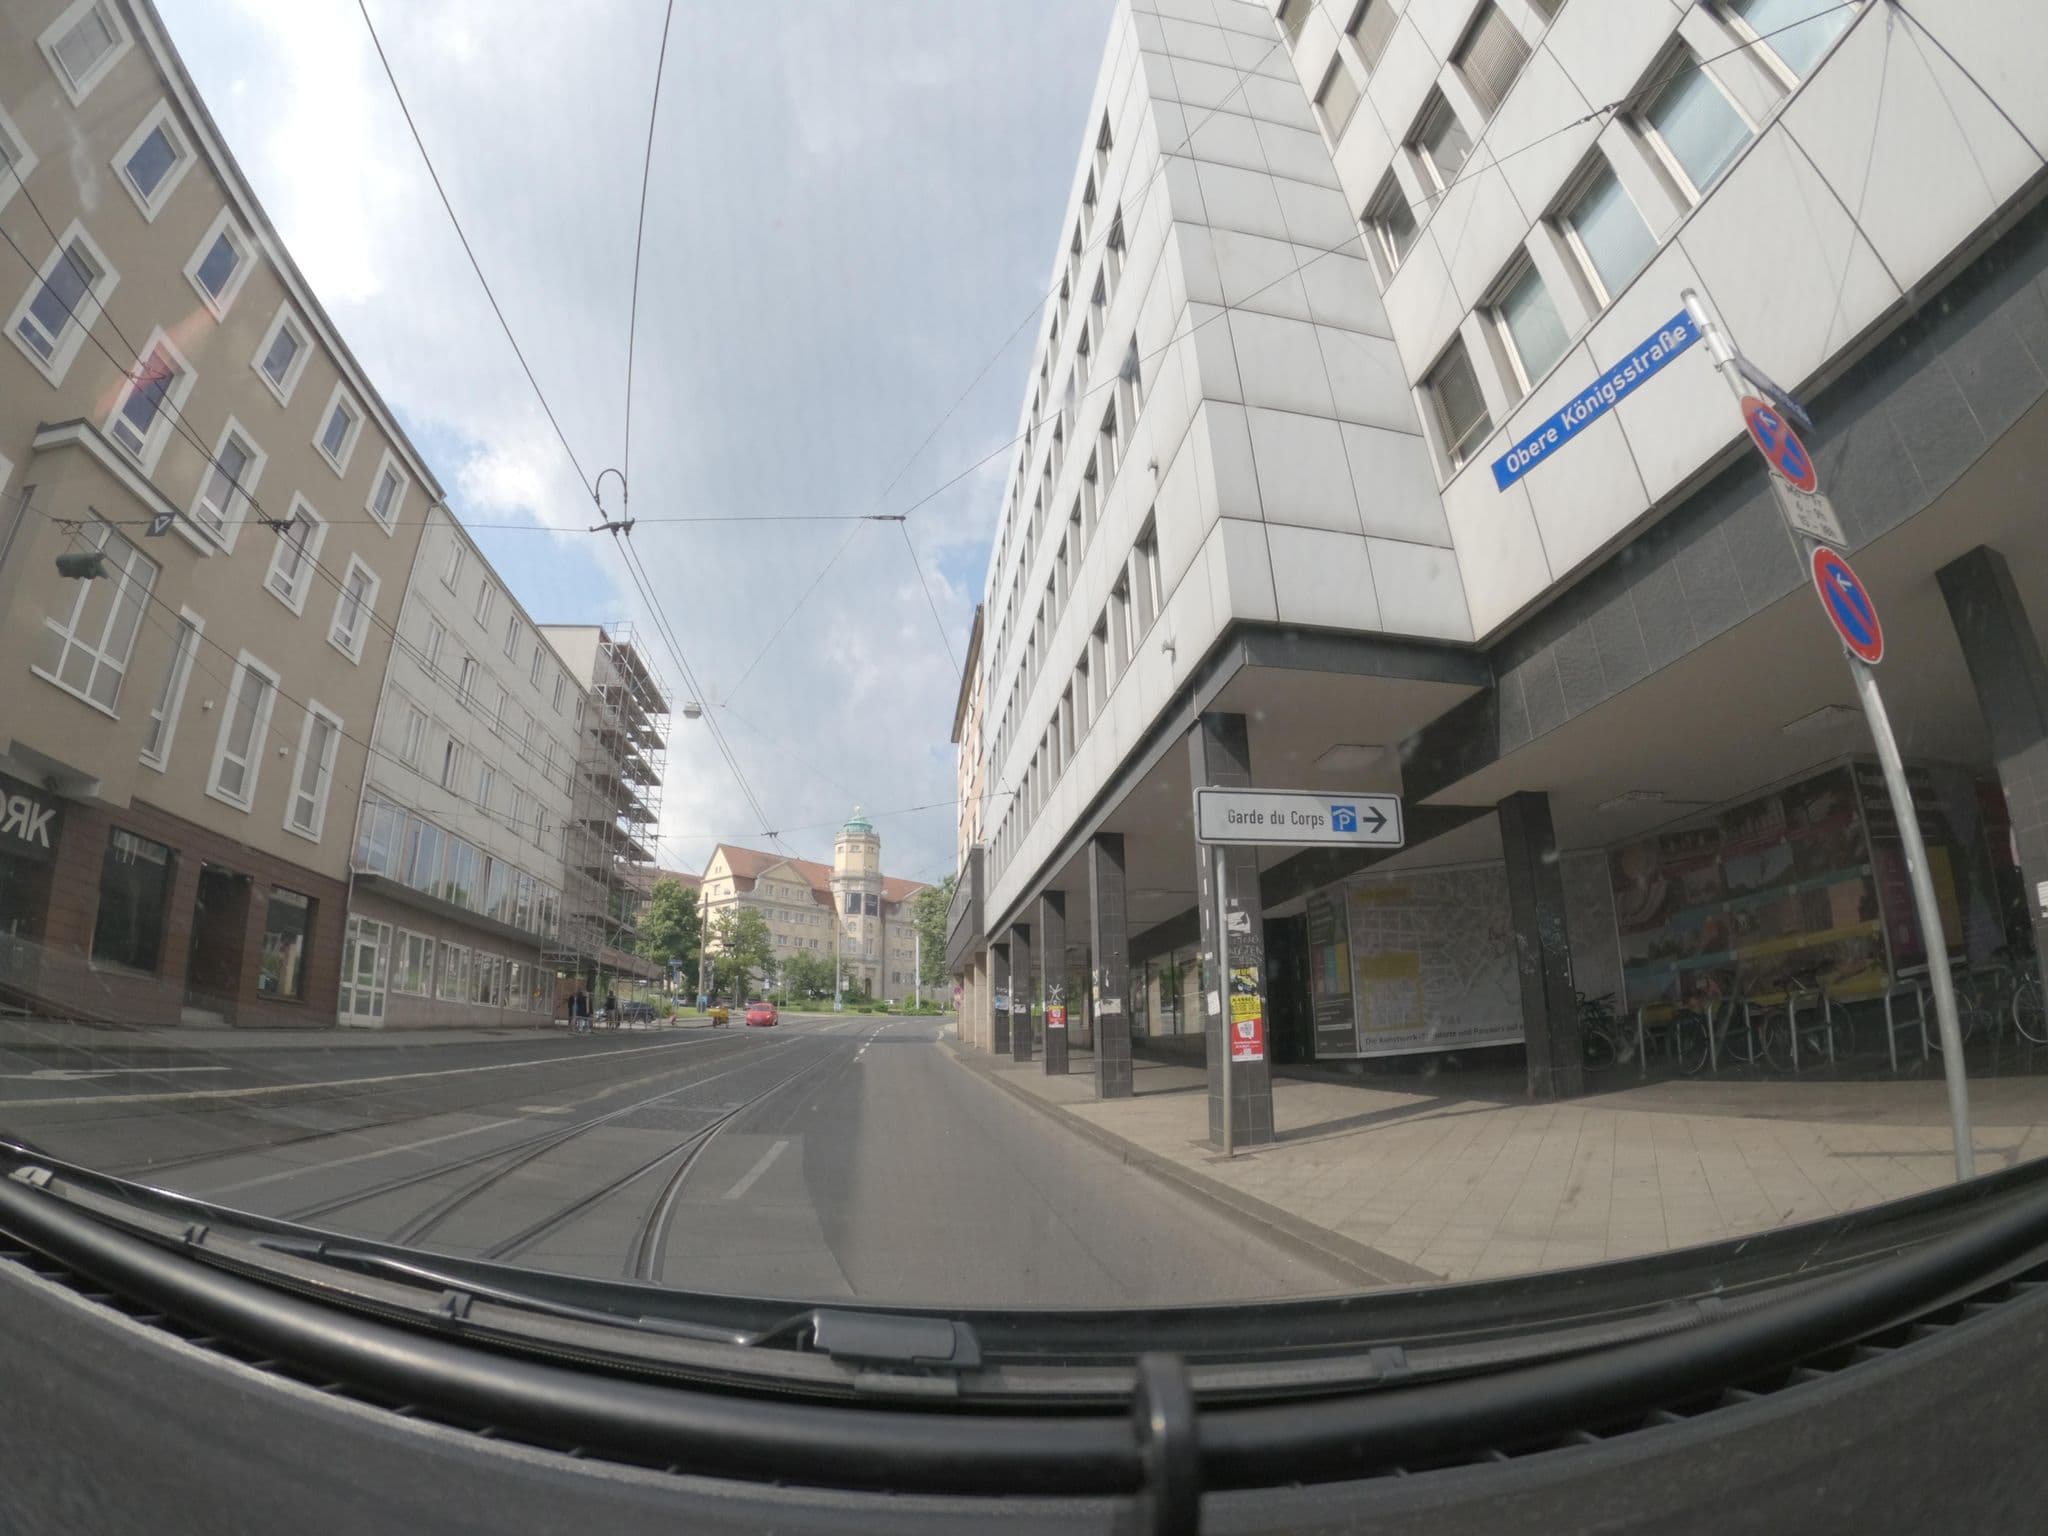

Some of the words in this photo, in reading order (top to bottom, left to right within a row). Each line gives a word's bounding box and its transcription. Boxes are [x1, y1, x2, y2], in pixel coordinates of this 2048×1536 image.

[1506, 427, 1559, 473] Obere
[1561, 325, 1688, 431] Königsstraße
[1228, 808, 1264, 825] Garde
[1270, 810, 1285, 825] du
[1290, 810, 1325, 829] Corps
